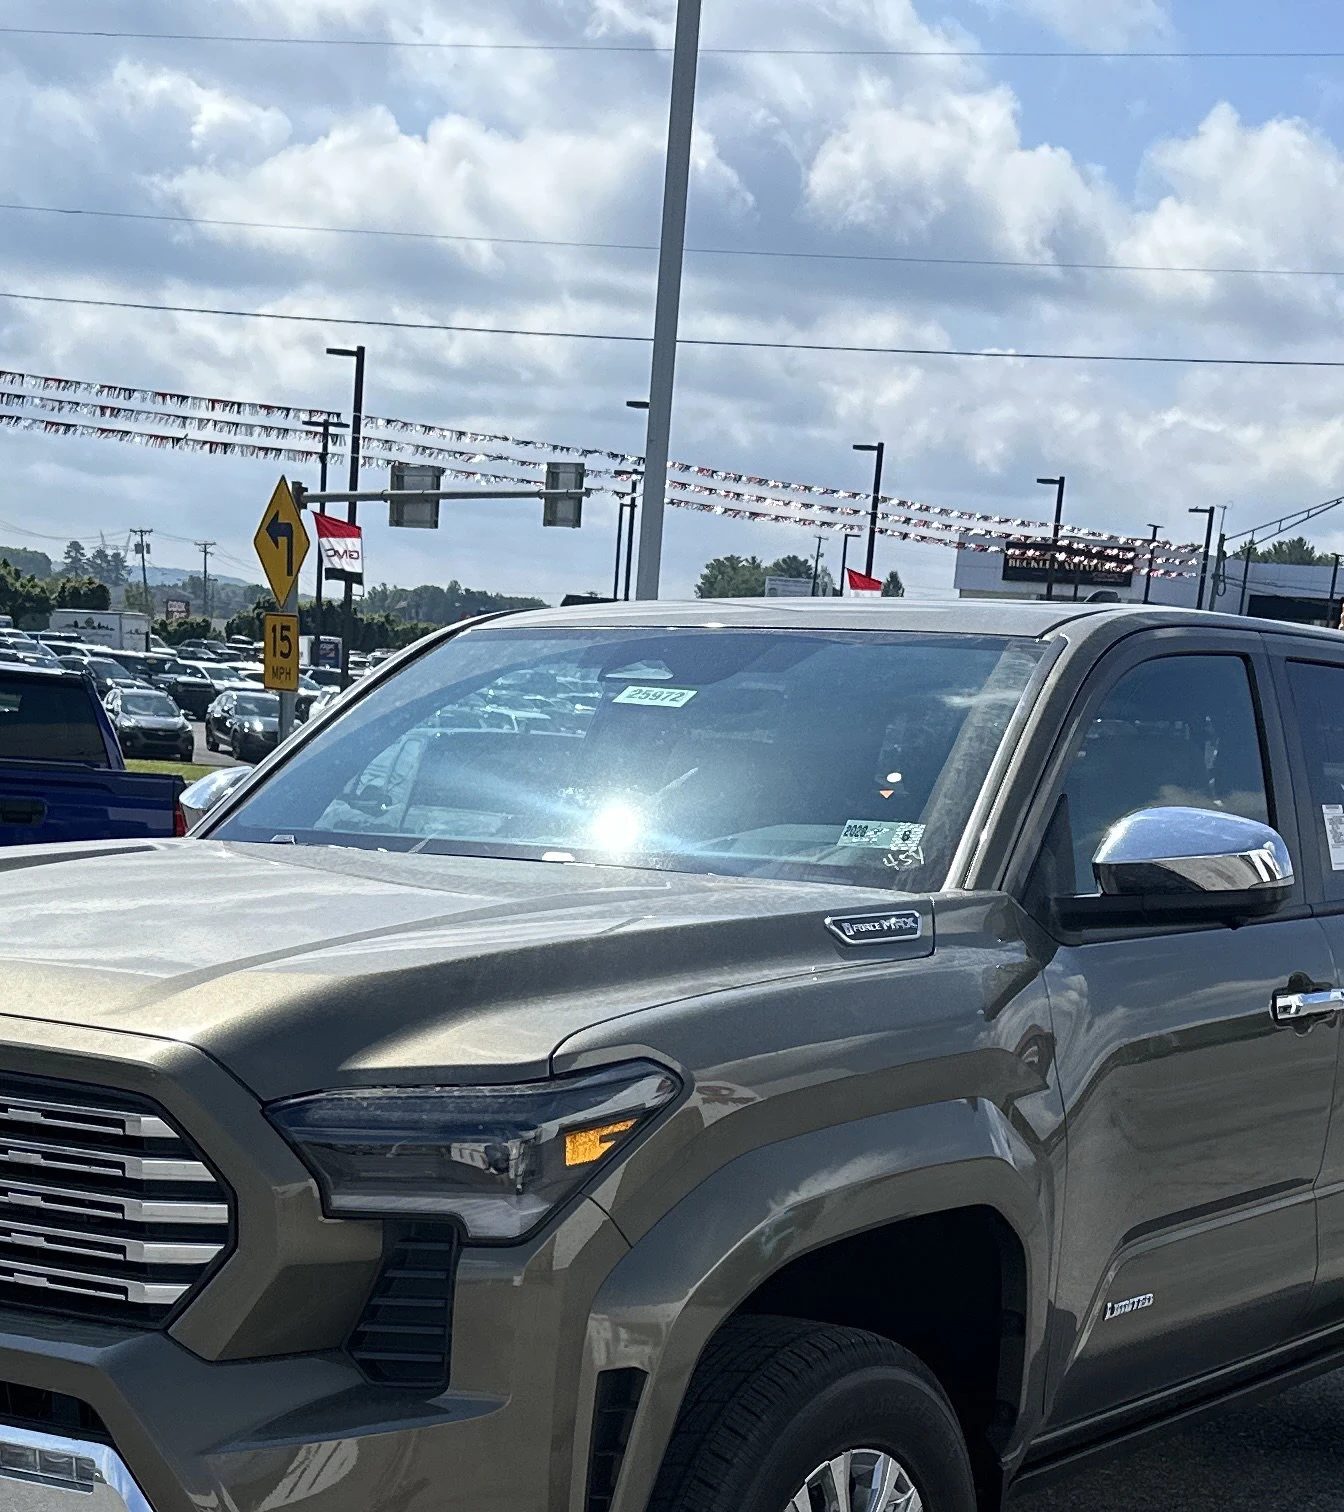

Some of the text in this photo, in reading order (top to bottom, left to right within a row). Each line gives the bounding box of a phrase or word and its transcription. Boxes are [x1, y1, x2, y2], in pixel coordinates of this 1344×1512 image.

[271, 624, 293, 659] 15
[271, 666, 292, 681] MPH
[625, 688, 686, 702] 25972
